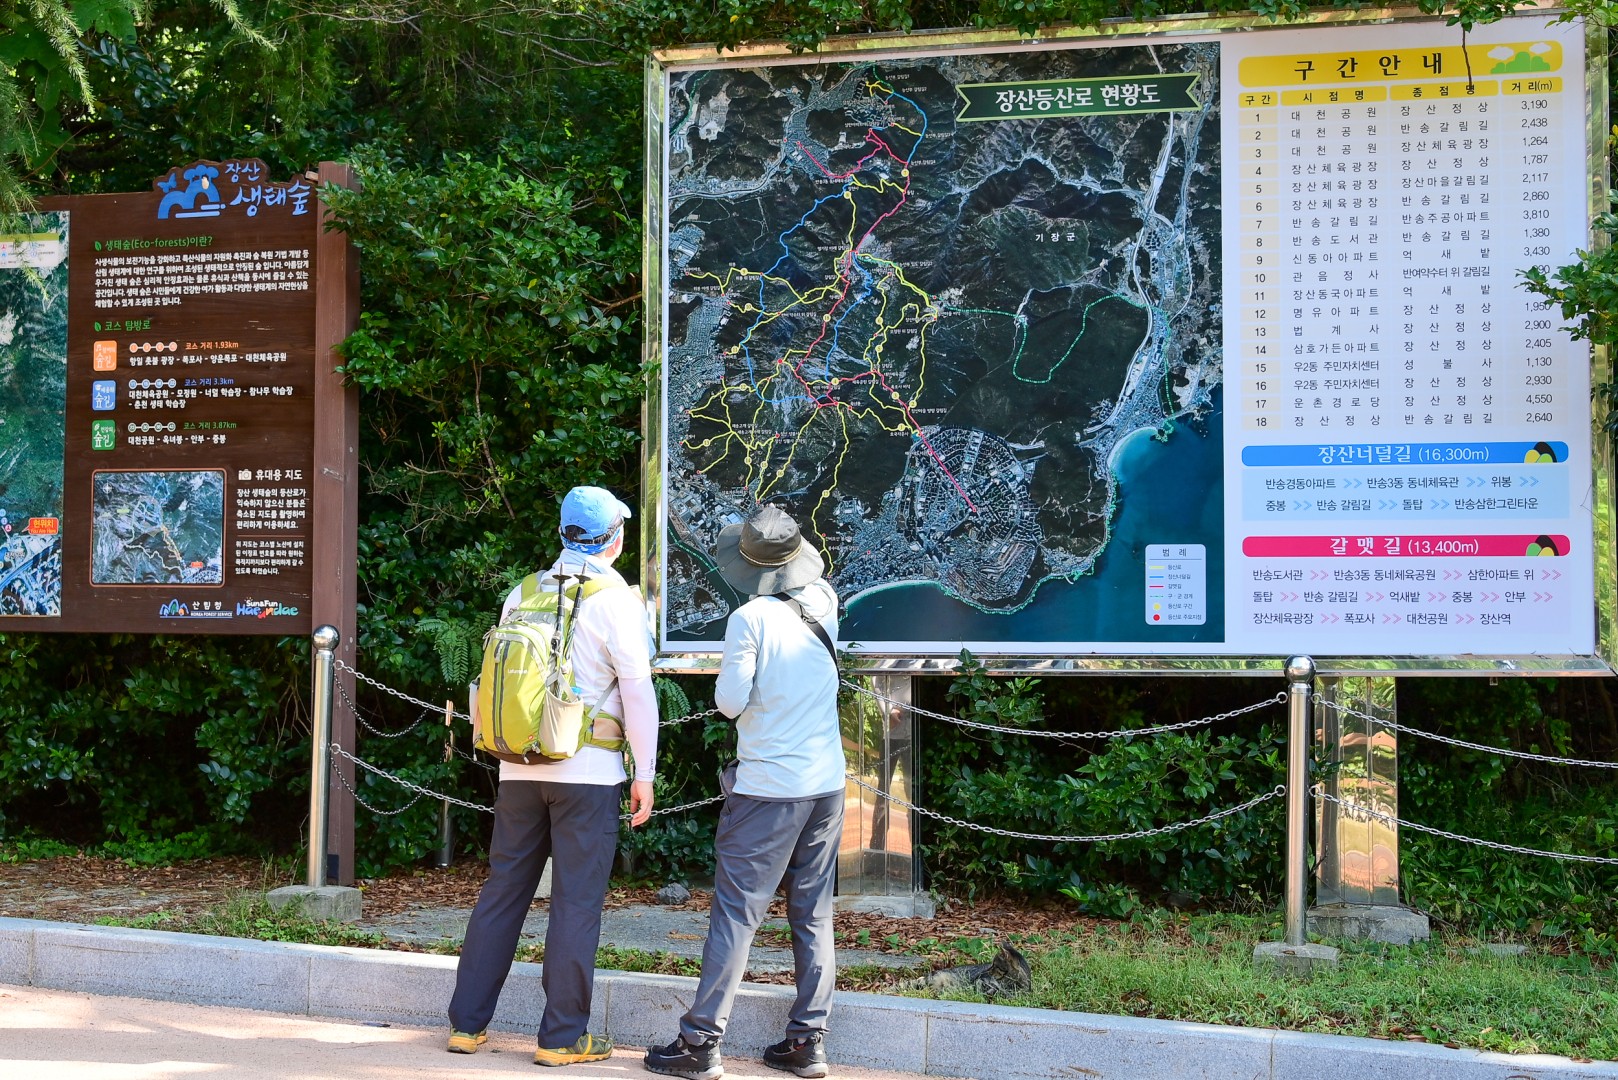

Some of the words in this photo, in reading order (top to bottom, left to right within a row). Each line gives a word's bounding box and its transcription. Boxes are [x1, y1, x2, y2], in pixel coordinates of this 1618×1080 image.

[995, 89, 1094, 113] 장산등산로
[1100, 83, 1161, 107] 현황도
[1255, 113, 1260, 123] 1
[1520, 99, 1548, 111] 3,190
[1254, 130, 1262, 141] 2
[1521, 117, 1549, 130] 2,438
[1255, 148, 1262, 159] 3
[1522, 135, 1549, 148] 1,264
[224, 162, 261, 183] 장산
[1255, 166, 1263, 176] 4
[1522, 154, 1549, 166] 1,787
[1255, 184, 1263, 194] 5
[1522, 172, 1549, 185] 2,117
[230, 179, 311, 218] 생태숲
[1255, 201, 1263, 212] 6
[1522, 190, 1550, 203] 2,860
[1255, 219, 1263, 230] 7
[1522, 208, 1550, 221] 3,810
[1255, 237, 1263, 248] 8
[1523, 227, 1551, 240] 1,380
[1256, 255, 1263, 266] 9
[1523, 245, 1551, 258] 3,430
[1254, 273, 1266, 284] 10
[1402, 267, 1448, 280] 반여약수터
[1450, 267, 1461, 278] 위
[1462, 265, 1491, 278] 갈림길
[1254, 291, 1265, 301] 11
[1254, 308, 1267, 319] 12
[1525, 301, 1551, 313] 1,950
[104, 321, 122, 331] 코스
[125, 320, 151, 332] 탐방로
[1254, 326, 1267, 337] 13
[1524, 319, 1552, 331] 2,900
[185, 342, 198, 350] 코스
[200, 341, 213, 350] 거리
[214, 341, 239, 349] 1.93km
[1255, 344, 1267, 355] 14
[1525, 337, 1552, 350] 2,405
[1255, 363, 1267, 373] 15
[1293, 360, 1318, 372] 우2동
[1323, 359, 1380, 372] 주민자치센터
[1525, 356, 1553, 369] 1,130
[184, 378, 197, 387] 코스
[199, 378, 212, 386] 거리
[213, 377, 234, 386] 3.3km
[1255, 380, 1267, 391] 16
[1293, 378, 1318, 390] 우2동
[1323, 377, 1380, 390] 주민자치센터
[1525, 374, 1553, 387] 2,930
[220, 387, 242, 398] 학습장
[272, 386, 293, 396] 학습장
[1255, 399, 1267, 409] 17
[1525, 393, 1553, 407] 4,550
[183, 421, 197, 430] 코스
[198, 421, 211, 430] 거리
[212, 421, 237, 430] 3.87km
[1255, 416, 1268, 427] 18
[1525, 412, 1553, 424] 2,640
[1317, 445, 1413, 465] 장산너덜길
[1418, 446, 1490, 463] (16,300m)
[255, 468, 282, 481] 휴대용
[284, 469, 303, 481] 지도
[1265, 477, 1337, 491] 반송경동아파트
[1366, 476, 1405, 490] 반송3동
[1406, 476, 1460, 490] 동네체육관
[1490, 475, 1513, 489] 위봉
[237, 488, 250, 498] 장산
[1265, 499, 1287, 512] 중봉
[1316, 499, 1338, 512] 반송
[1340, 498, 1371, 512] 갈림길
[1401, 498, 1424, 511] 돌탑
[1454, 497, 1539, 511] 반송삼한그린타운
[33, 519, 54, 529] 현위치
[1407, 538, 1479, 556] (13,400m)
[1252, 569, 1304, 582] 반송도서관
[1333, 568, 1371, 582] 반송3동
[1373, 568, 1436, 582] 동네체육공원
[1467, 568, 1521, 582] 삼한아파트
[1523, 568, 1534, 581] 위
[246, 599, 278, 608] Sun&Fun
[1252, 590, 1274, 603] 돌탑
[1303, 590, 1325, 604] 반송
[1327, 590, 1359, 603] 갈림길
[1389, 590, 1421, 604] 억새밭
[1451, 590, 1474, 604] 중봉
[1504, 590, 1527, 604] 안부
[1252, 612, 1314, 625] 장산체육광장
[1343, 612, 1376, 625] 폭포사
[1406, 612, 1448, 626] 대천공원
[1479, 612, 1511, 626] 장산역
